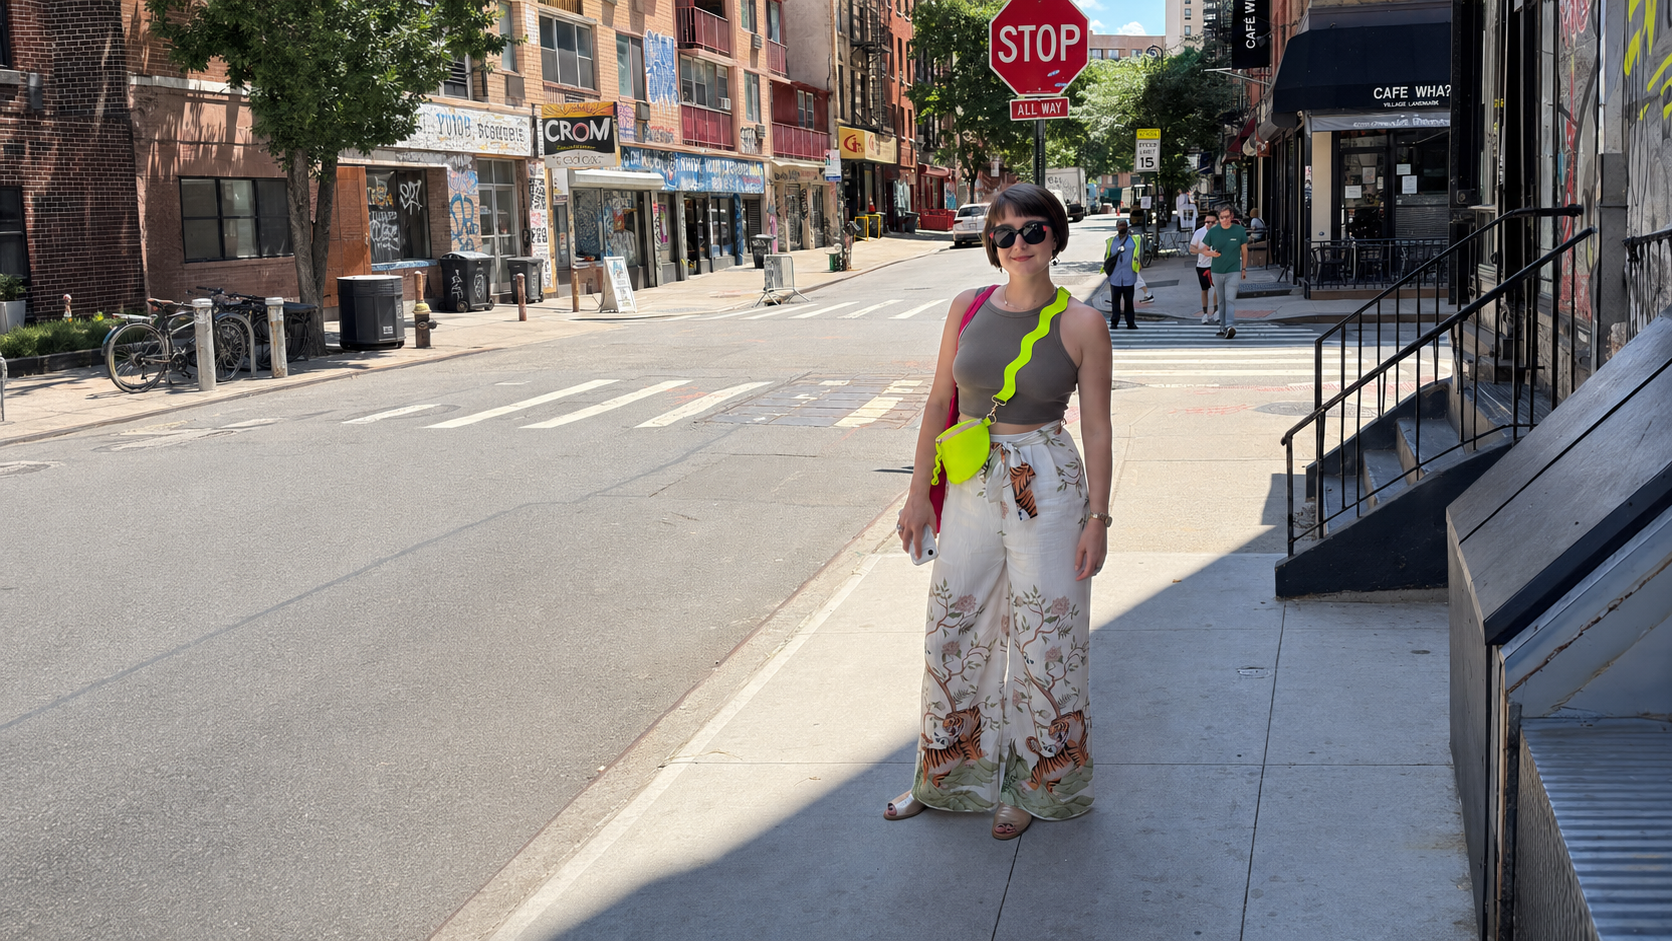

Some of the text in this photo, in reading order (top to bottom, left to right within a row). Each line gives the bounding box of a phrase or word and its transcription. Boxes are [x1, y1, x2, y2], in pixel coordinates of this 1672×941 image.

[998, 24, 1080, 63] STOP
[1373, 84, 1451, 99] CAFE WHA?
[1017, 102, 1062, 116] ALL WAY
[544, 117, 611, 143] CROM
[1140, 157, 1154, 168] 15
